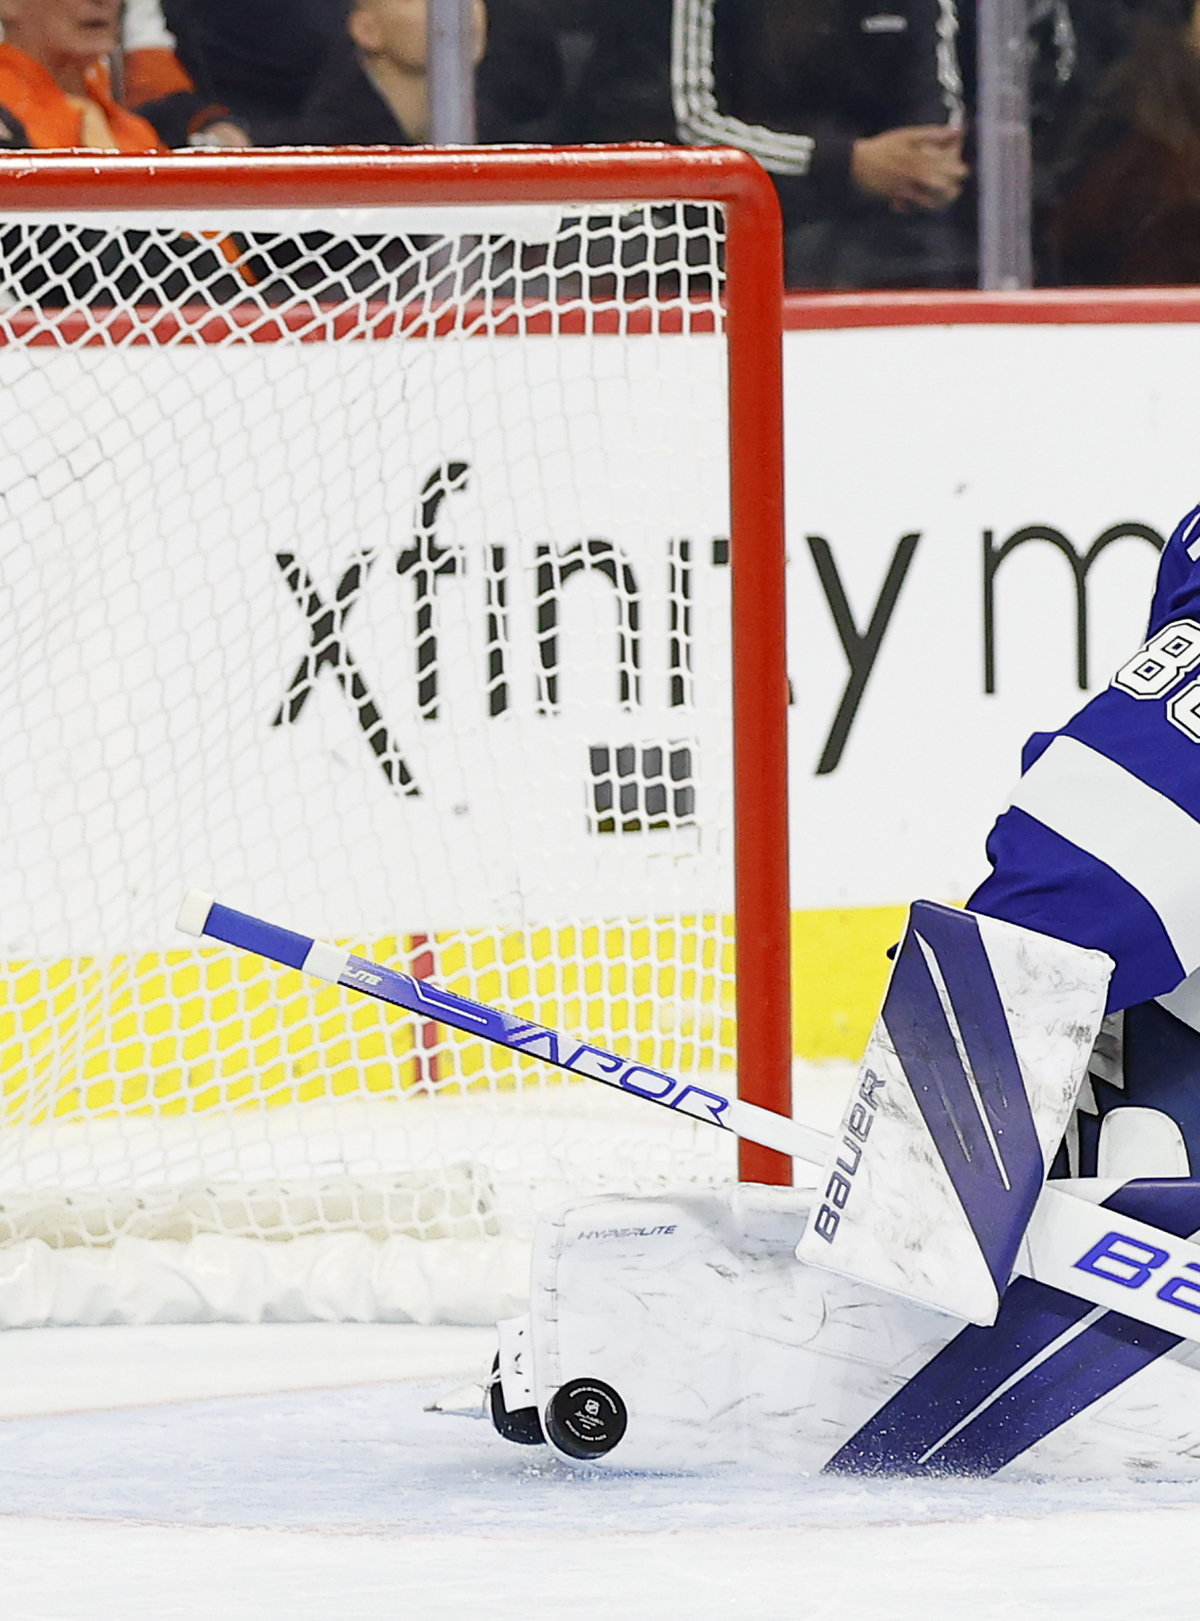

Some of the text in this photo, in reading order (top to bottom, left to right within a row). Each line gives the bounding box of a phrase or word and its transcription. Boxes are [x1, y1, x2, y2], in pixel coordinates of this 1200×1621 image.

[271, 461, 922, 797] xfiniy
[577, 1224, 678, 1241] HYPERLITE
[813, 1067, 887, 1245] BAUER
